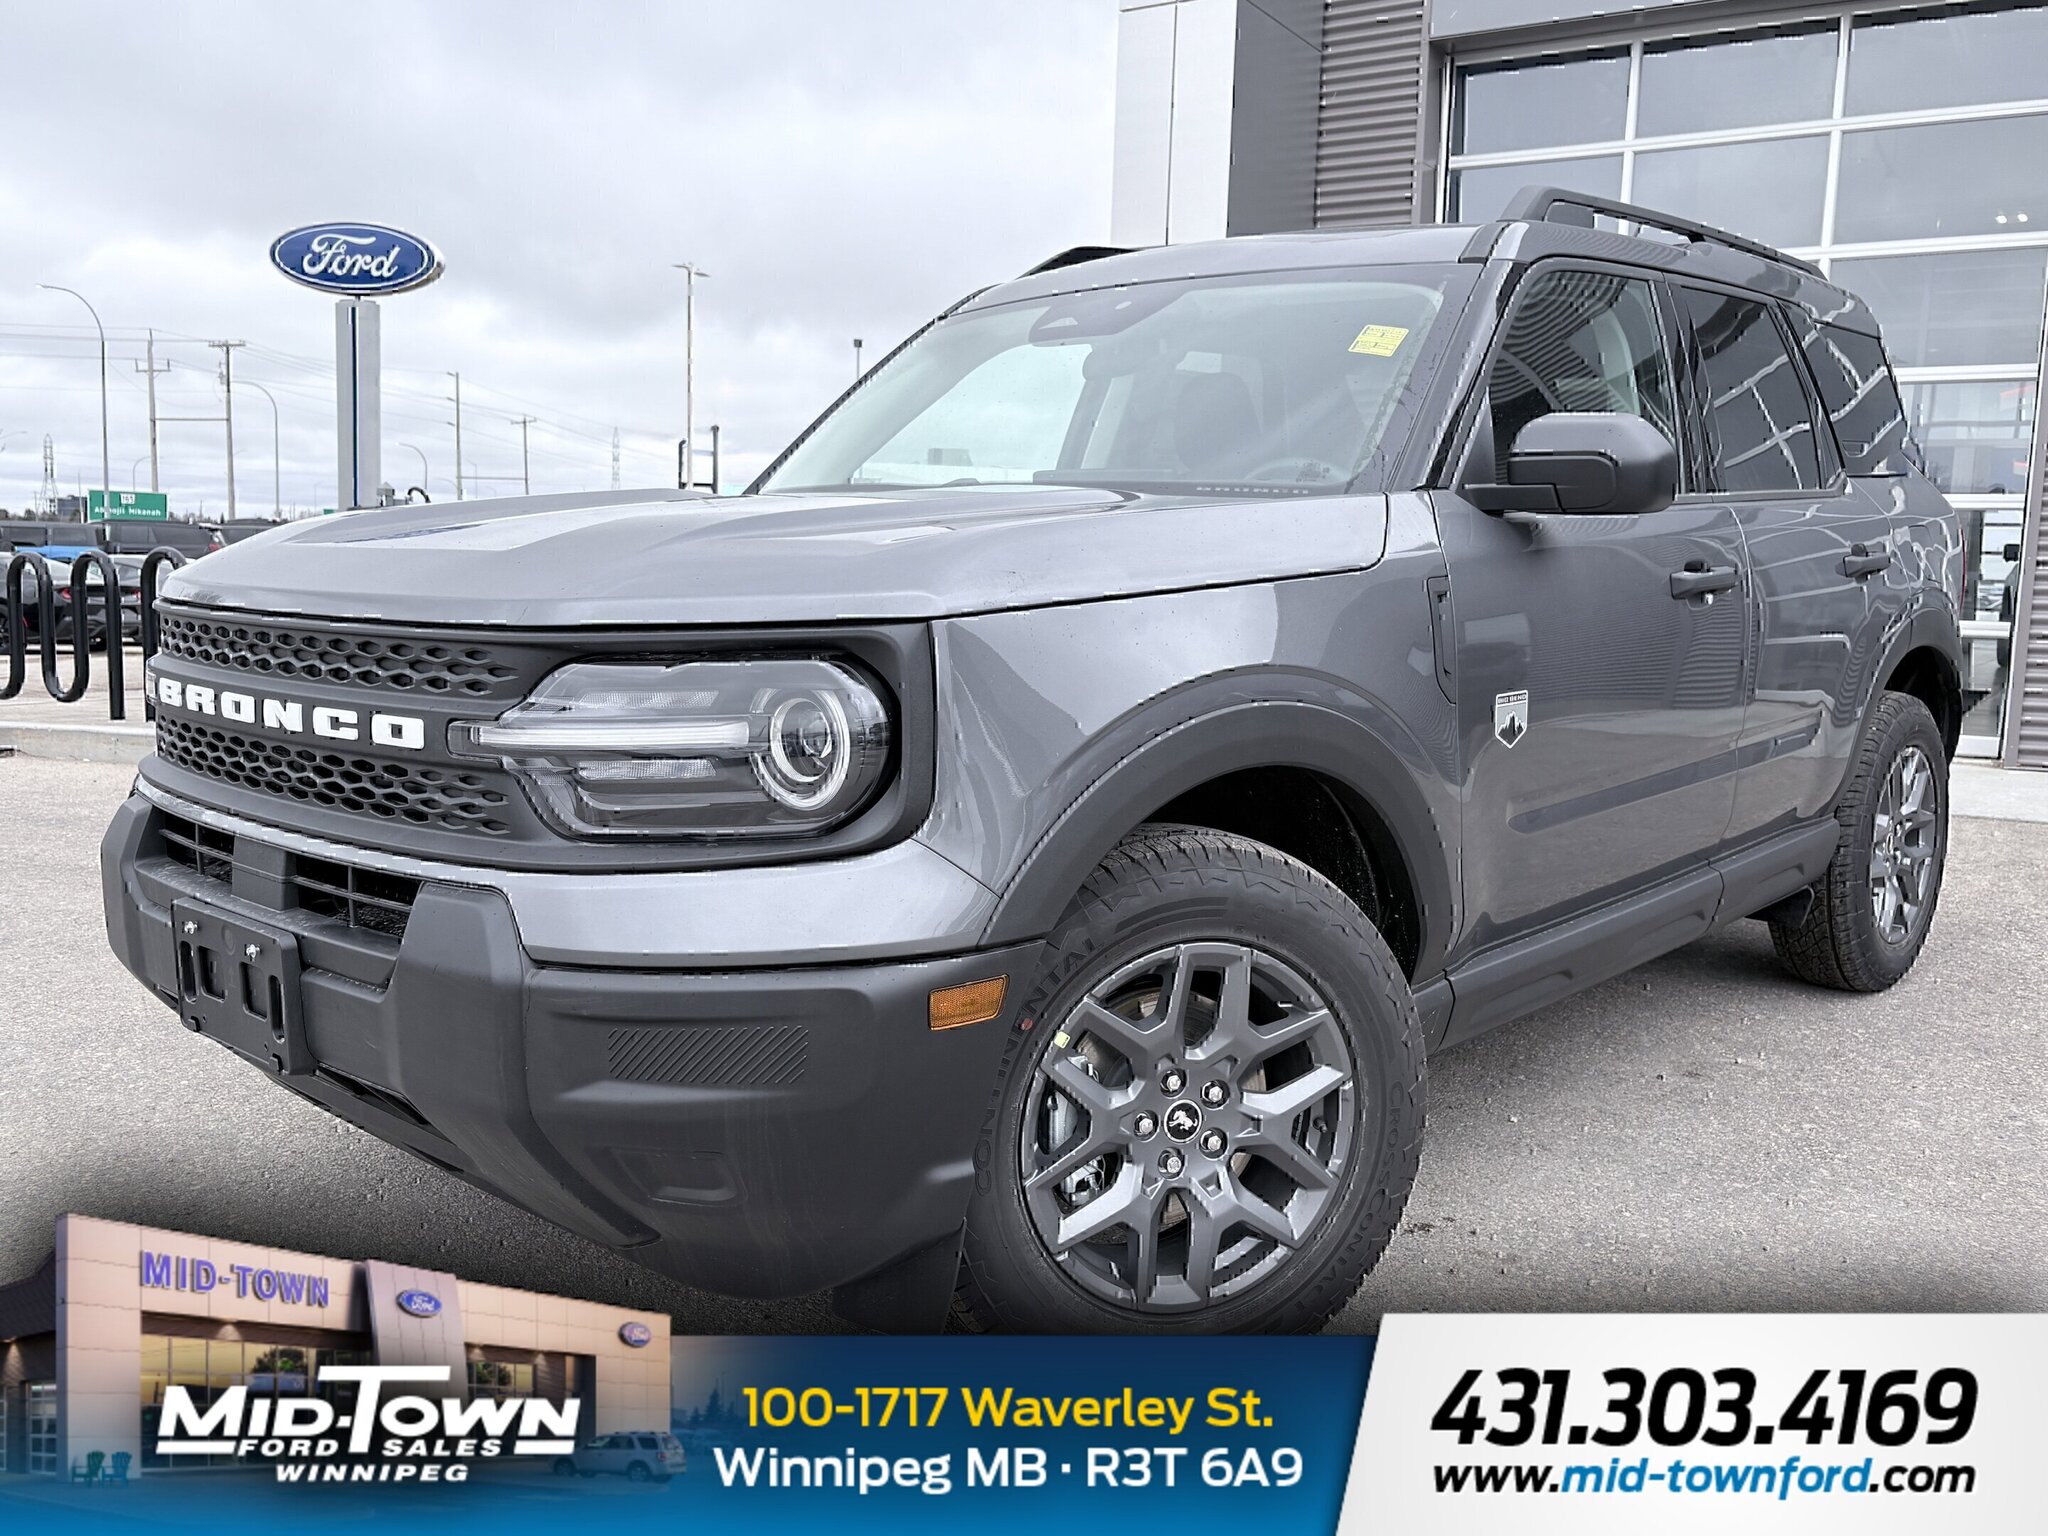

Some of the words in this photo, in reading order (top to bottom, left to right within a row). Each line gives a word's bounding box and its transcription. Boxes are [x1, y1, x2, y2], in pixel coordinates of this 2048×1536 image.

[303, 233, 400, 277] Ford
[128, 506, 161, 517] Mikanah
[158, 677, 425, 750] BRONCO
